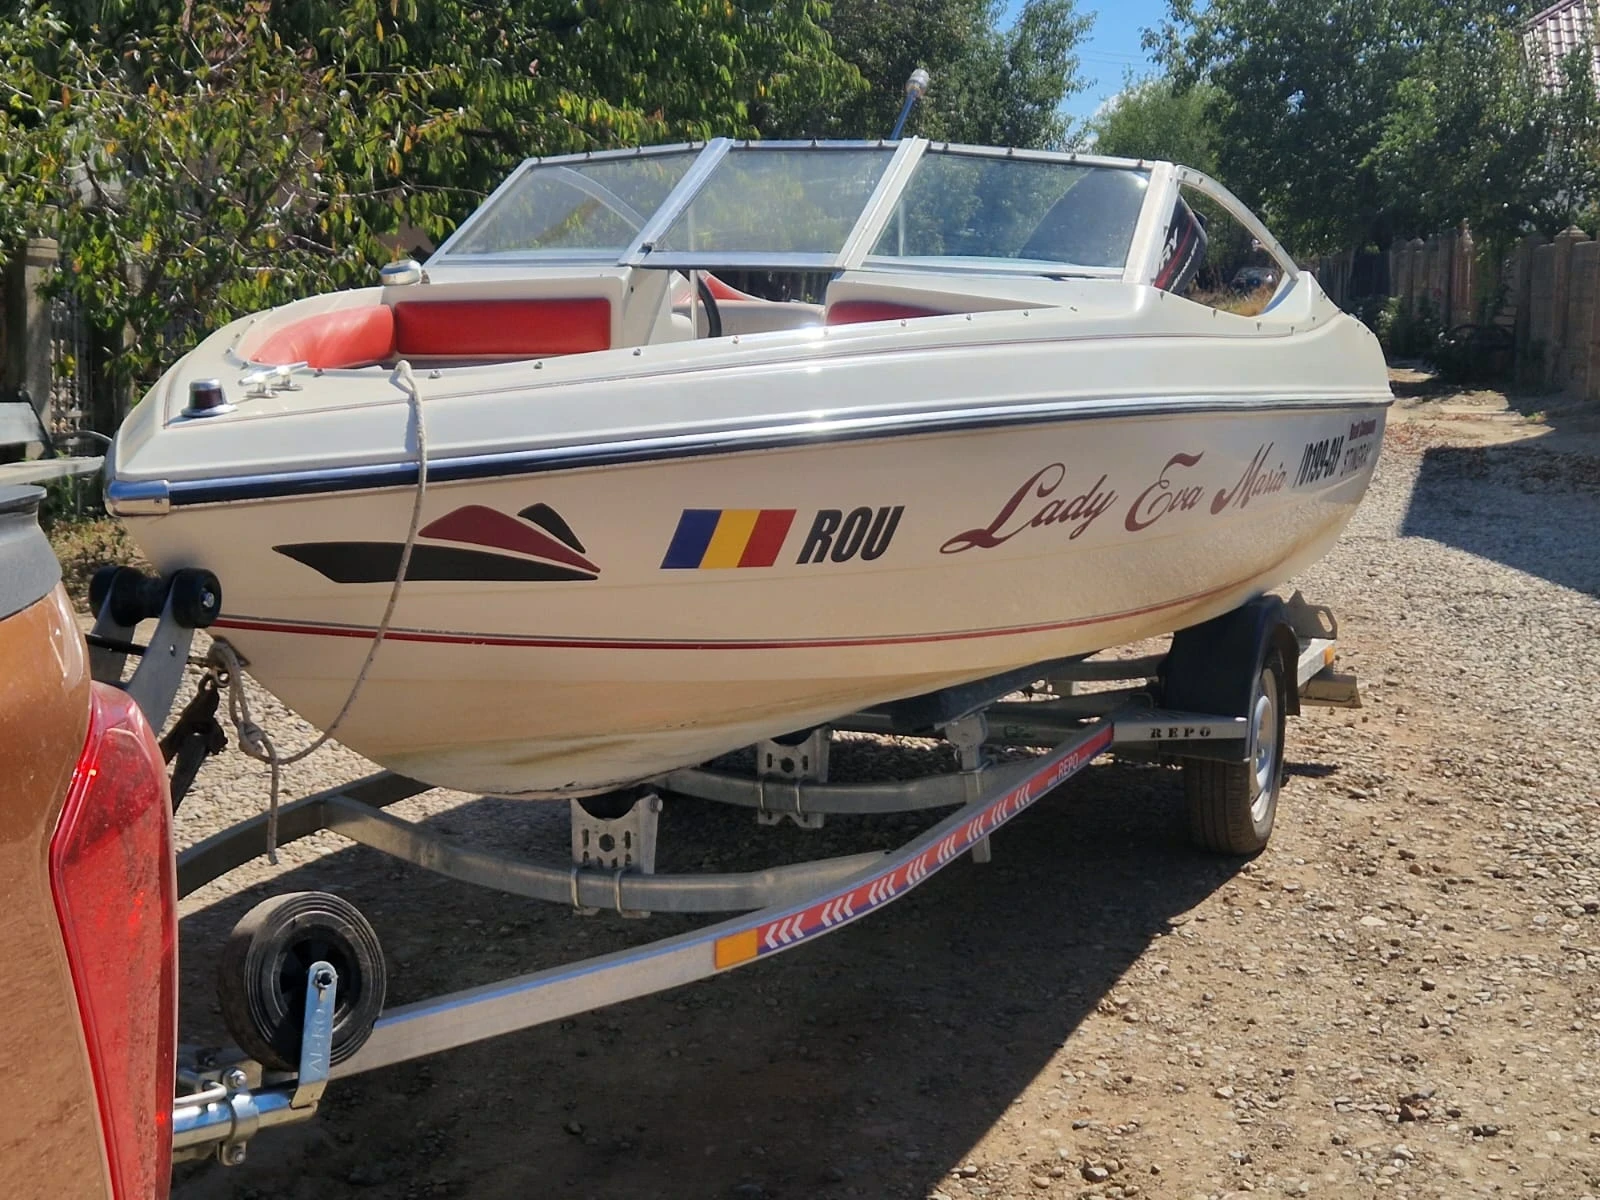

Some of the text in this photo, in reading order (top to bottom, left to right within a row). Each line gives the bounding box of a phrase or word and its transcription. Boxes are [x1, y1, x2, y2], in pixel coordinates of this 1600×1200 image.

[940, 441, 1287, 554] Lady Eva Maria
[796, 506, 905, 564] ROU
[1150, 726, 1211, 739] REPO
[1058, 752, 1079, 779] REPO
